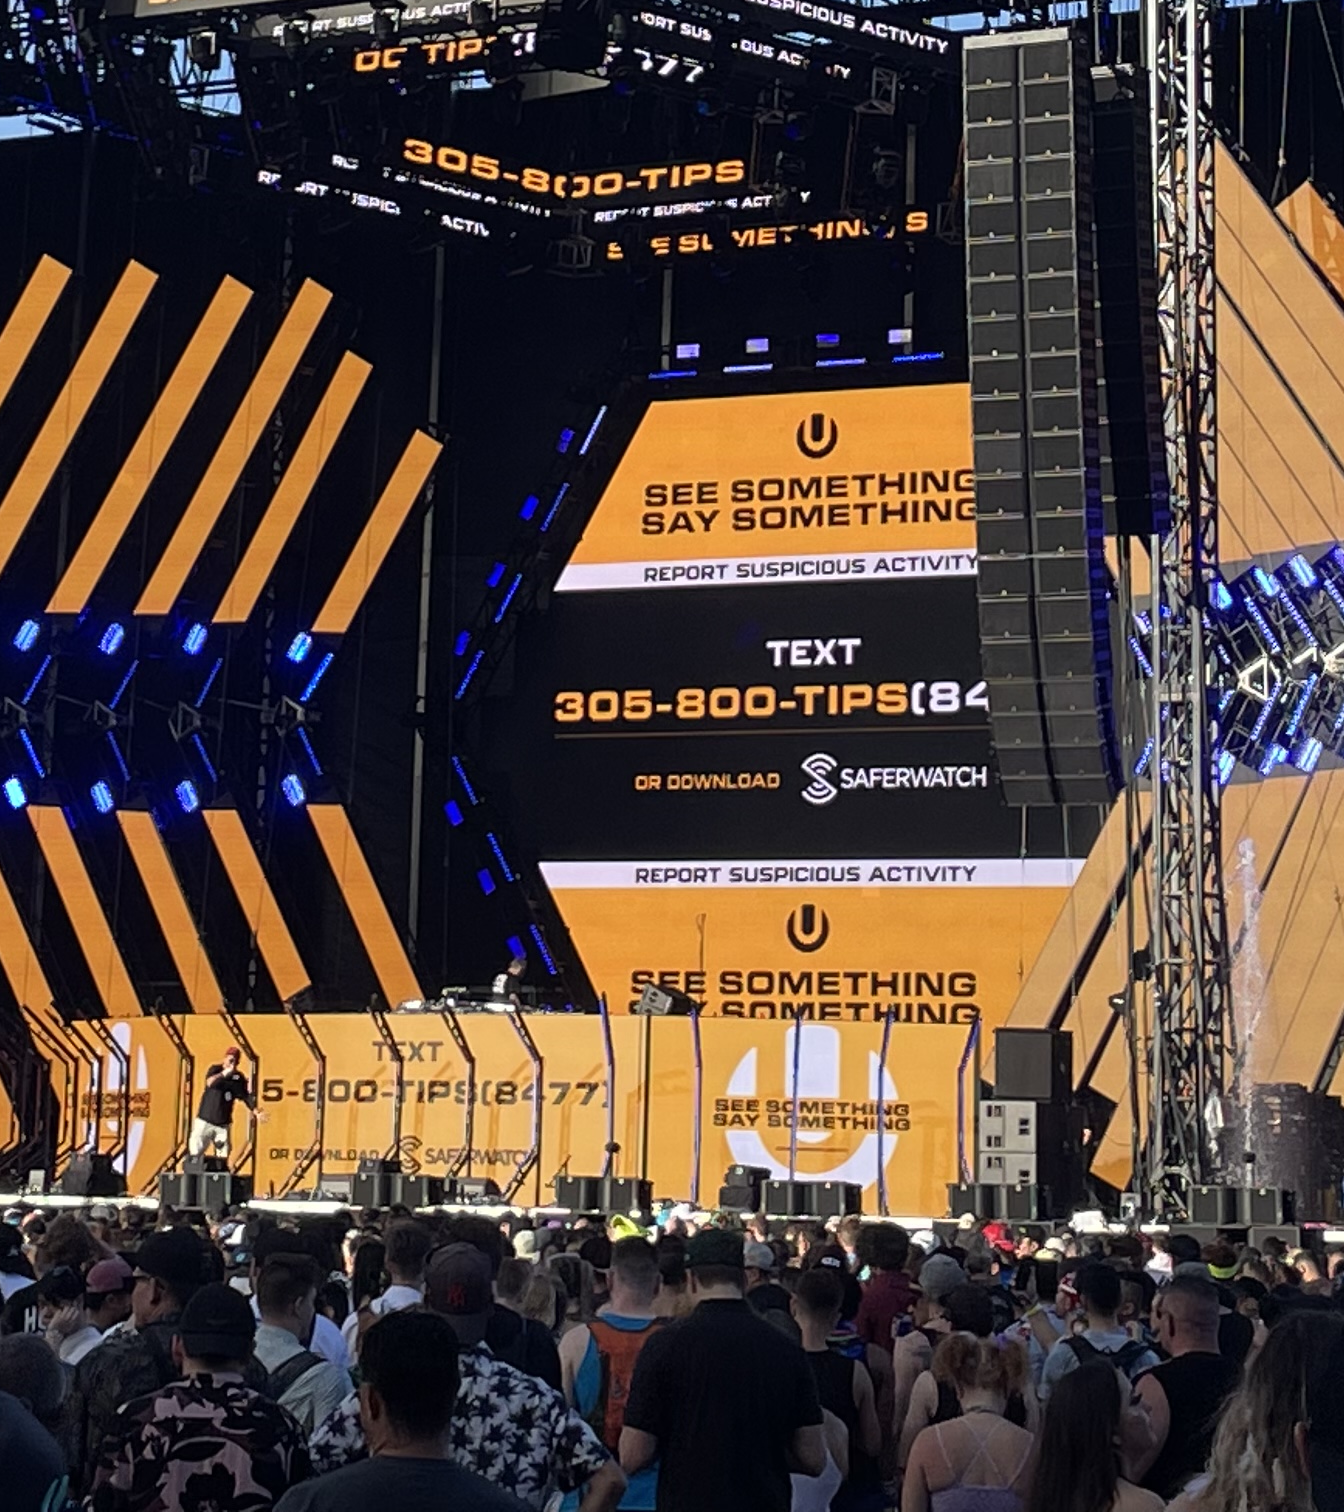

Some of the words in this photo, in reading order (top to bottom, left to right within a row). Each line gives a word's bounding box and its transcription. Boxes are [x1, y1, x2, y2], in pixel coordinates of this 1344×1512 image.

[860, 20, 950, 55] ACTIVITY
[644, 481, 719, 507] SEE
[731, 468, 975, 503] SOMETHING
[642, 509, 720, 535] SAY
[732, 498, 977, 531] SOMETHING
[644, 564, 729, 583] REPORT
[736, 558, 866, 579] SUSPICIOUS
[873, 553, 979, 574] ACTIVITY
[766, 638, 862, 667] TEXT
[634, 774, 662, 791] OR
[666, 772, 781, 791] DOWNLOAD
[840, 765, 988, 789] SAFERWATCH
[635, 866, 722, 884] REPORT
[728, 865, 860, 884] SUSPICIOUS
[868, 864, 977, 883] ACTIVITY
[719, 970, 978, 997] SOMETHING
[715, 1098, 760, 1114] SEE
[713, 1113, 760, 1128] SAY
